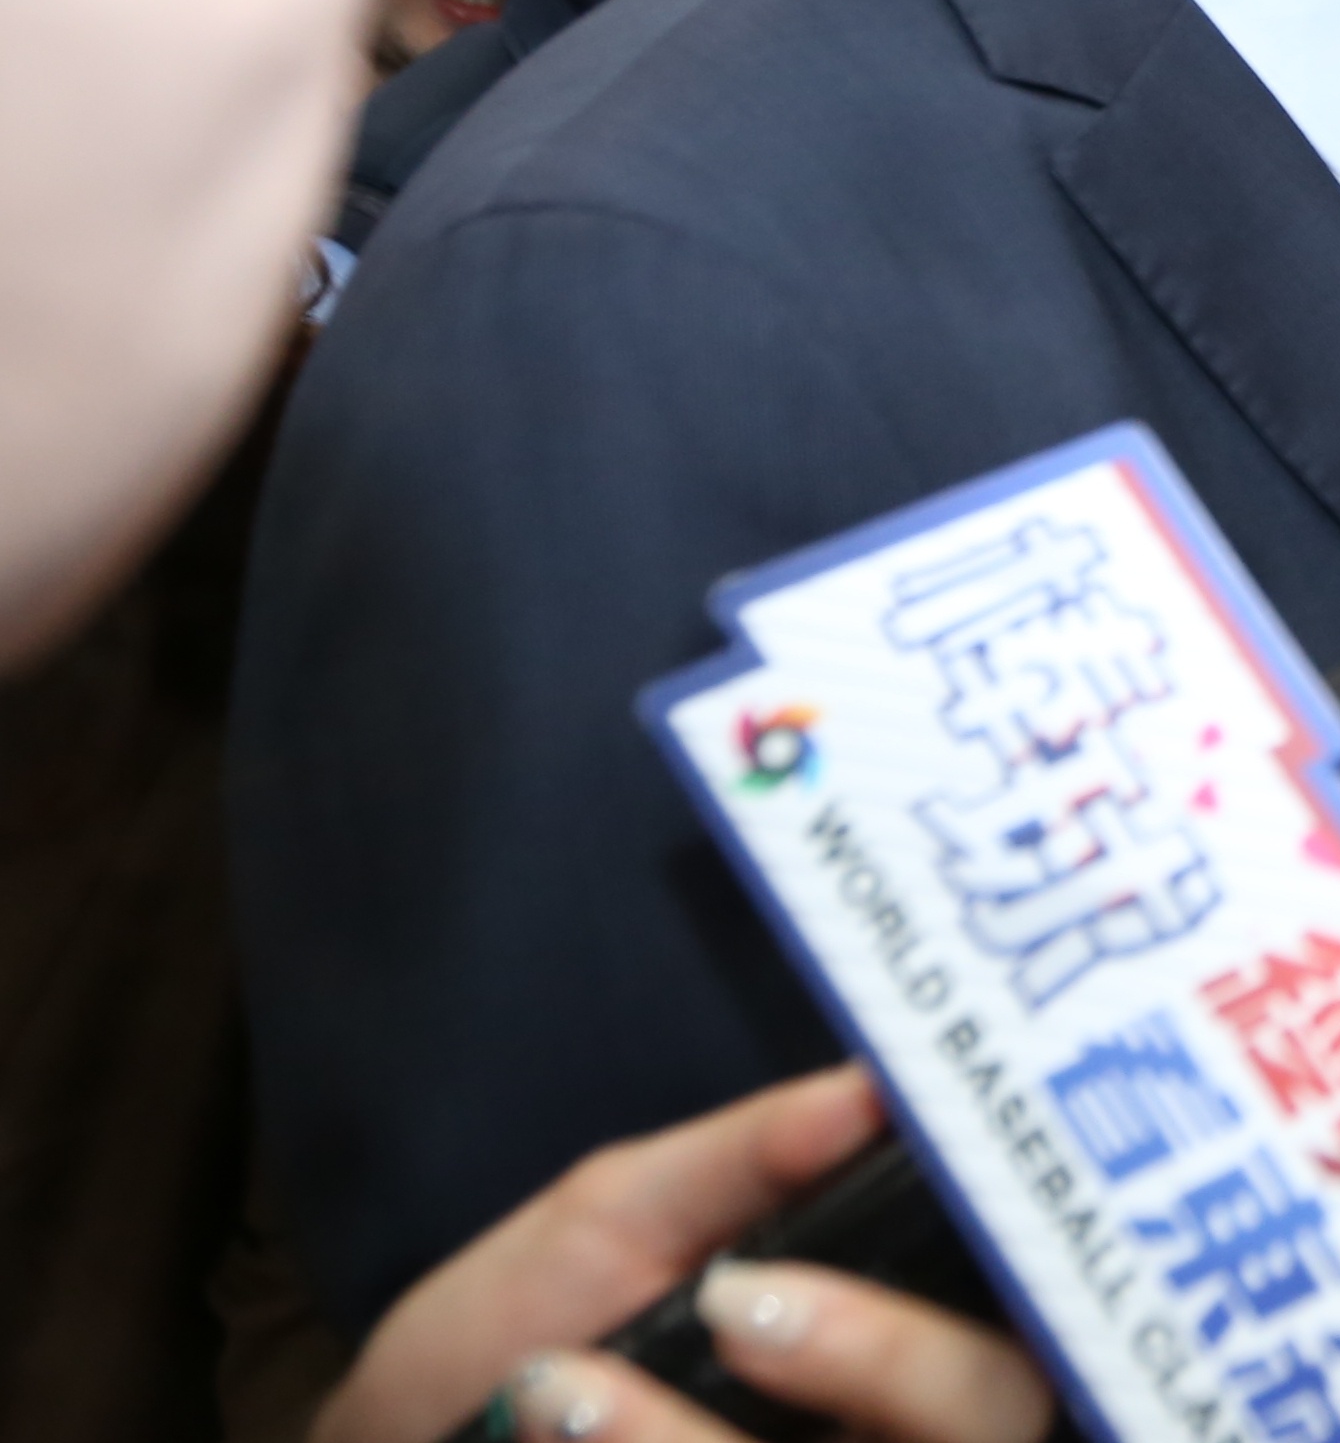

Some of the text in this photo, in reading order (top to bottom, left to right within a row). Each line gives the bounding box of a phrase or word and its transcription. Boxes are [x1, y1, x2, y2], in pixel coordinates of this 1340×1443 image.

[803, 799, 1244, 1443] WORLD BASEBALL CLA
